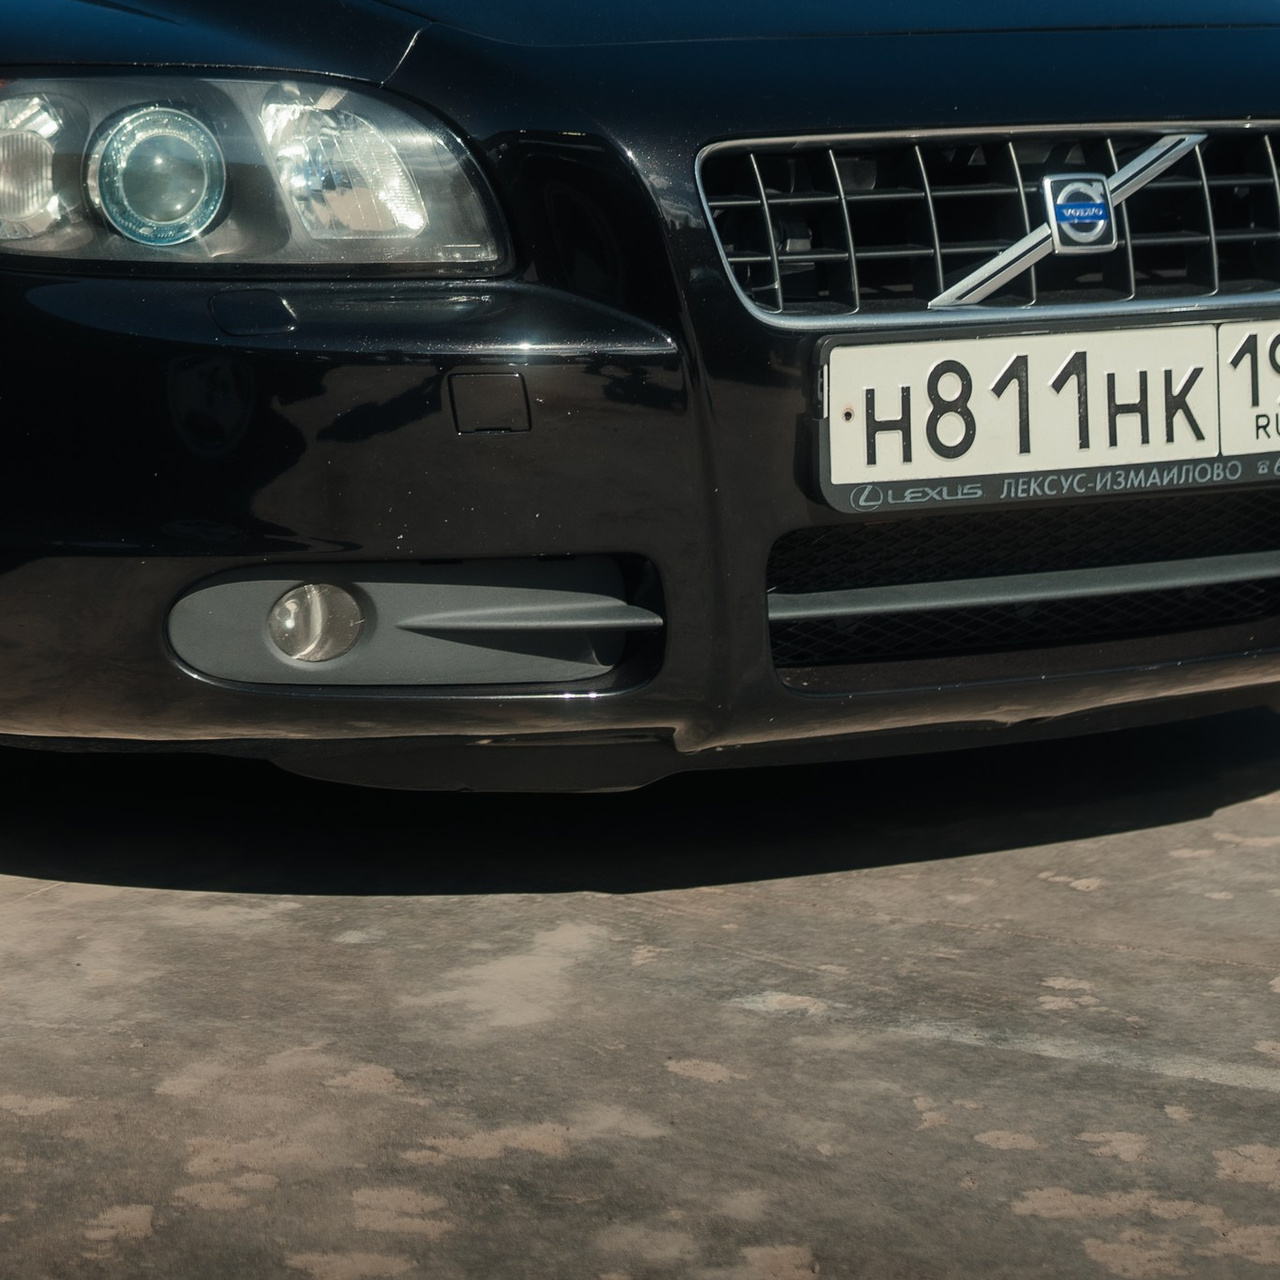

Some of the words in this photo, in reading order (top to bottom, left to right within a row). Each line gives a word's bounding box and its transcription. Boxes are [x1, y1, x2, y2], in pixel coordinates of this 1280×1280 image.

[1062, 207, 1103, 217] VOLVO
[1255, 413, 1280, 440] R
[887, 483, 983, 504] LEXUS
